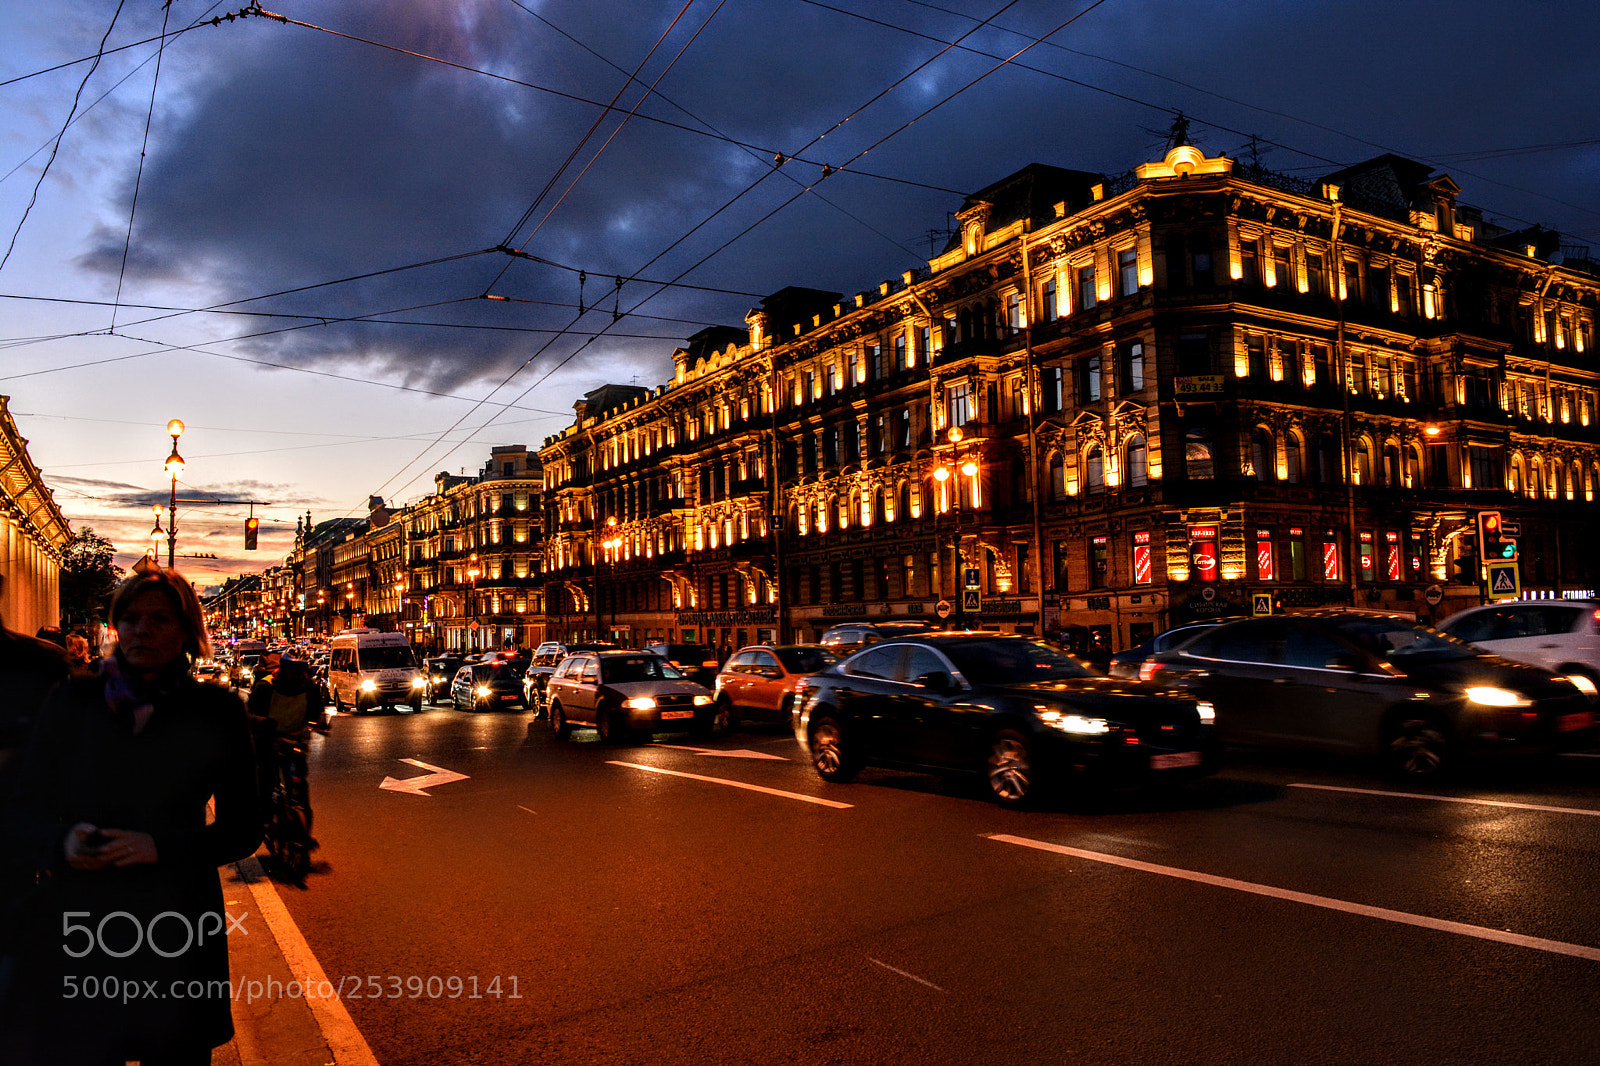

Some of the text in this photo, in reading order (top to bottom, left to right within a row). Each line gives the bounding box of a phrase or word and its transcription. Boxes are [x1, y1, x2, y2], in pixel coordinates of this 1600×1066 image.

[1180, 382, 1225, 392] 493 44 33
[1135, 548, 1150, 569] HOTELS
